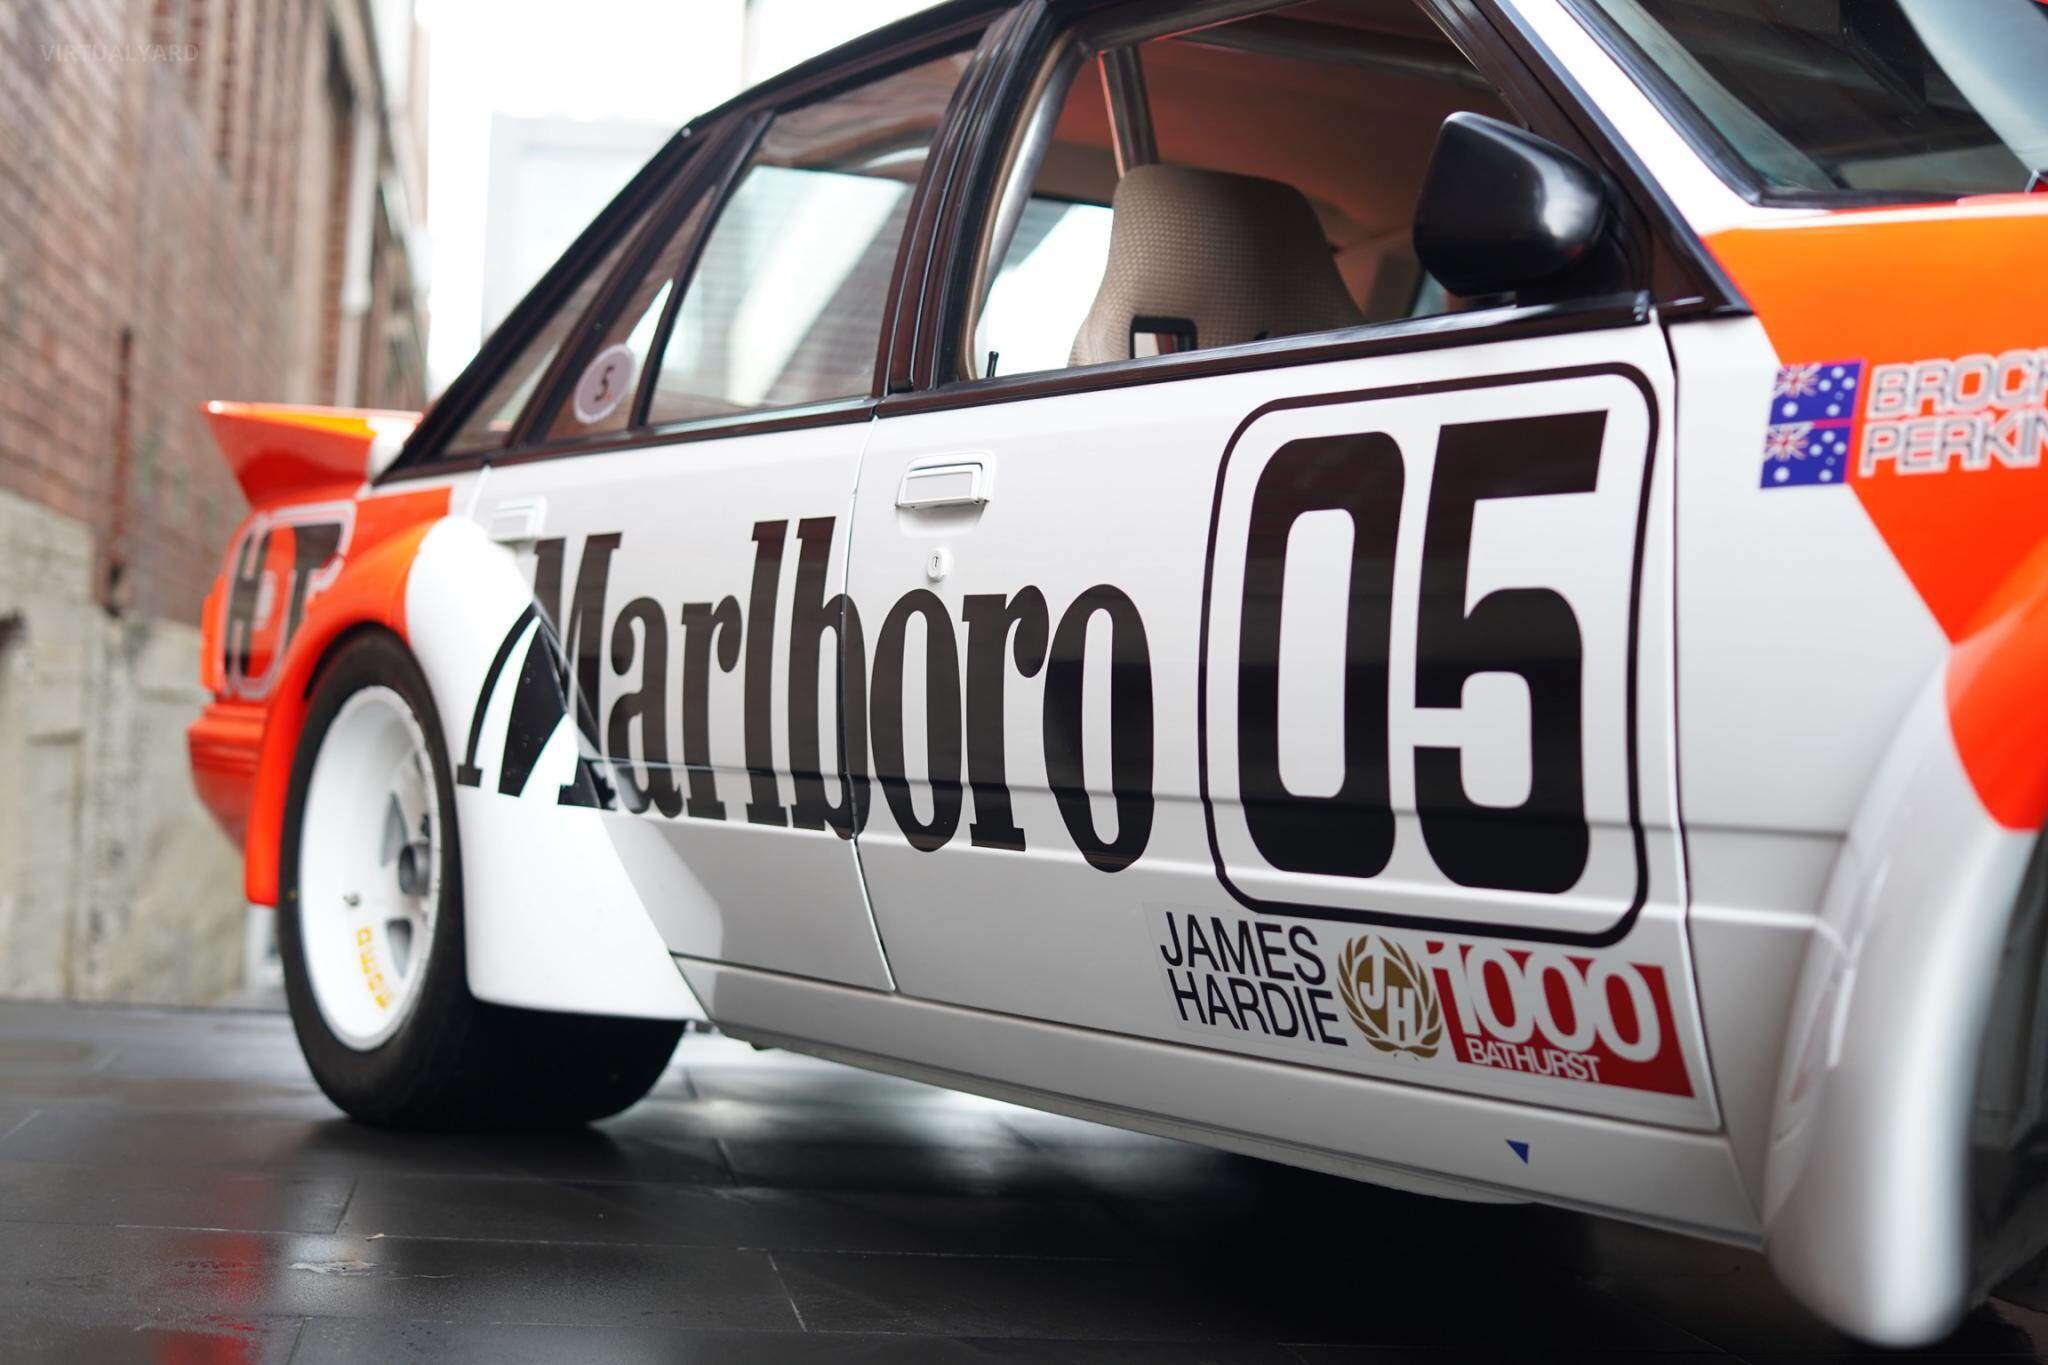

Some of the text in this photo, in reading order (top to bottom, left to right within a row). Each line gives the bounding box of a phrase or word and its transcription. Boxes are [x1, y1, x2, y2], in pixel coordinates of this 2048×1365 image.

[457, 516, 1154, 872] Marlboro
[1237, 409, 1608, 894] 05
[1160, 911, 1327, 985] JAMES
[1168, 968, 1349, 1047] HARDIE
[1430, 941, 1662, 1063] 1000
[1466, 1040, 1600, 1083] BATHURST
